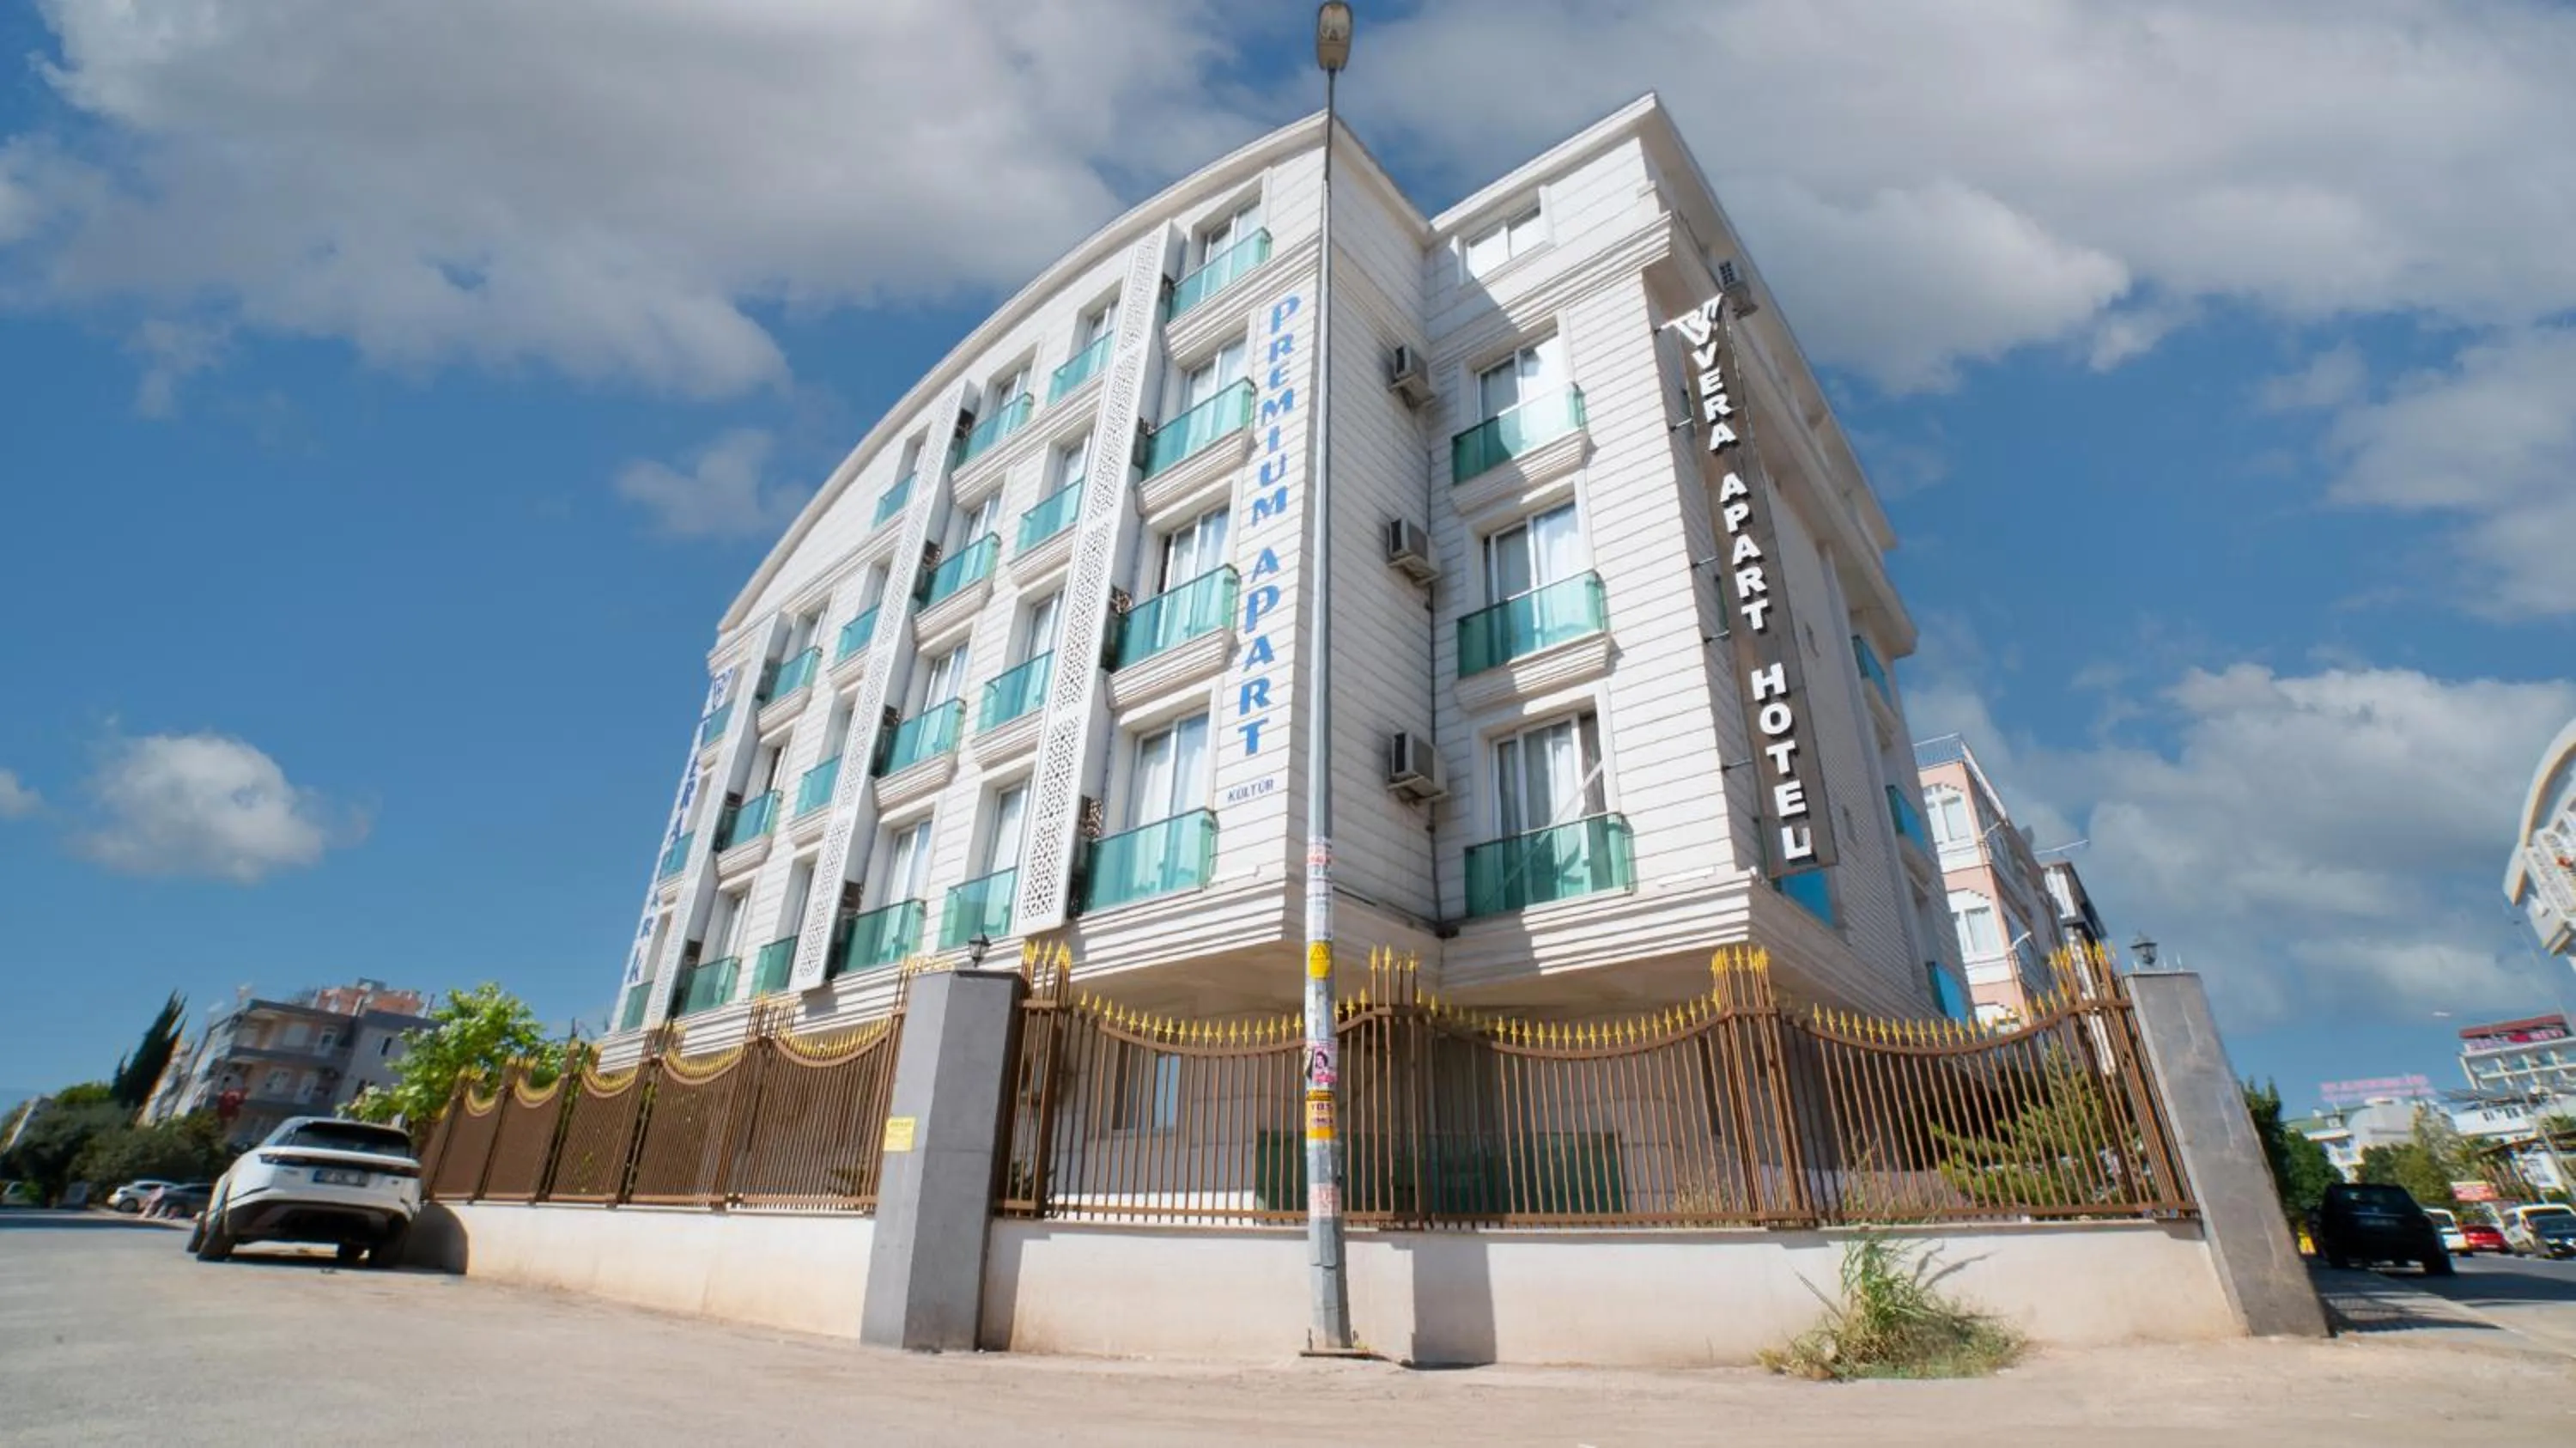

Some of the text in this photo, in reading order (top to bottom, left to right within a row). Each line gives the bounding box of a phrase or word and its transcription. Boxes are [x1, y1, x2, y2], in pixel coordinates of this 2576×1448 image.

[1238, 295, 1302, 755] PREMIUM APART
[1692, 340, 1737, 451] VERA
[1720, 472, 1771, 631] APART
[1750, 662, 1814, 861] HOTEL
